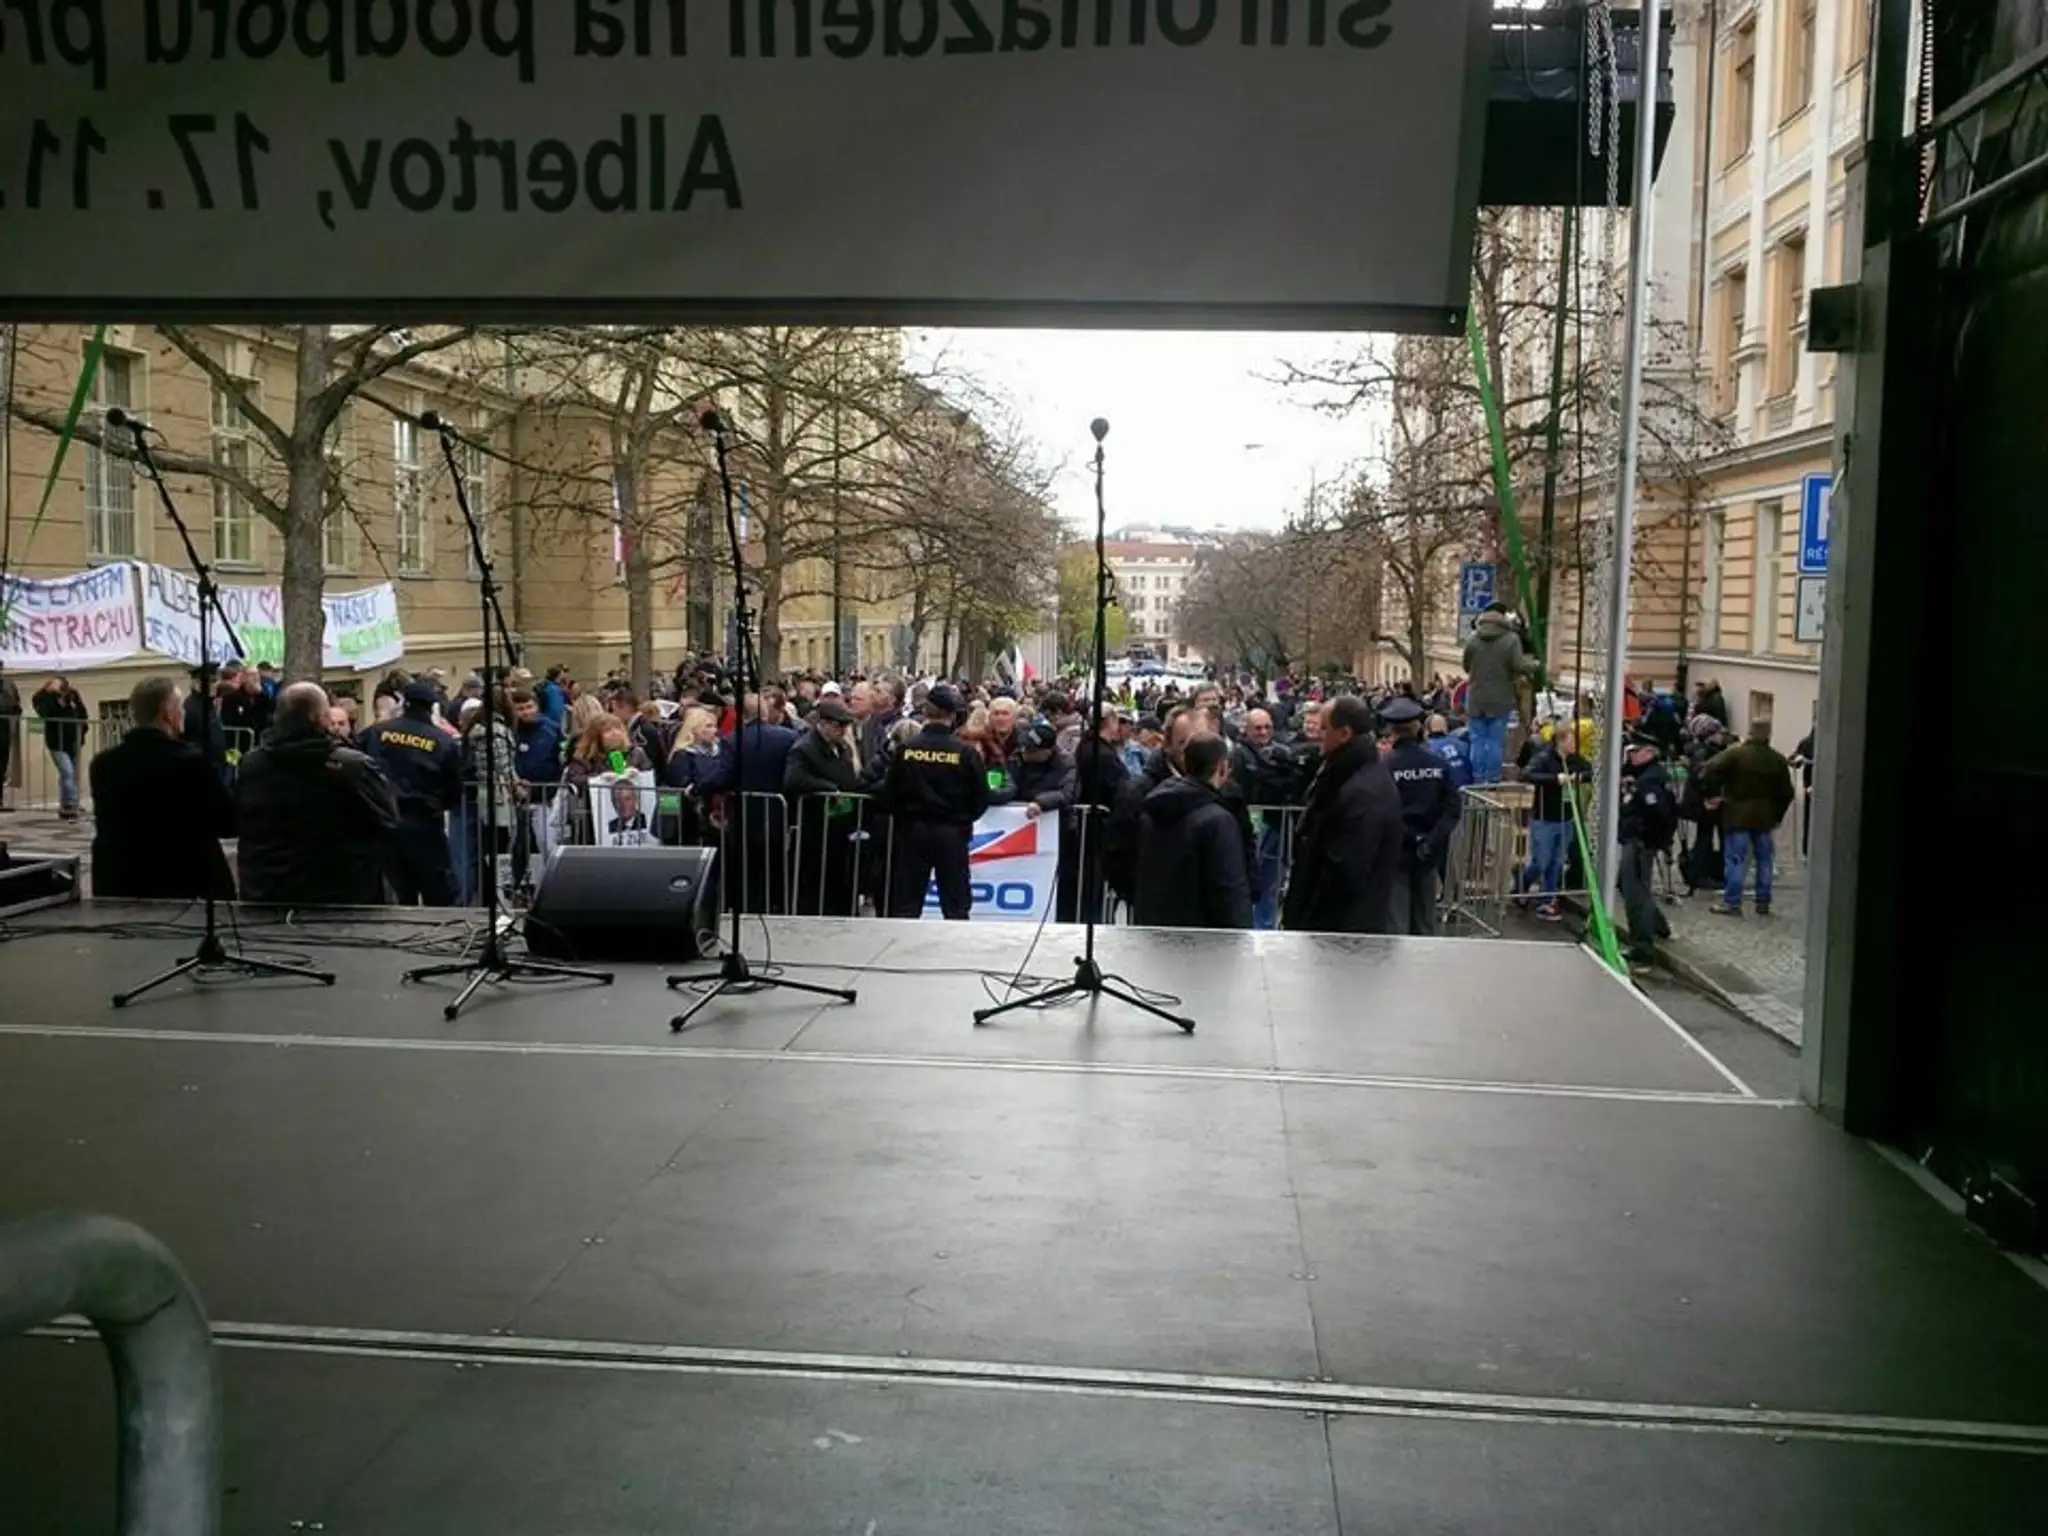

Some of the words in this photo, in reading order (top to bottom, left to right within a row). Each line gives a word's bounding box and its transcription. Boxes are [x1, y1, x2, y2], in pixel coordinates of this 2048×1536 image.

[29, 604, 134, 655] STRACHU
[381, 730, 437, 752] POLICIE
[903, 748, 961, 765] POLICIE
[1393, 767, 1444, 781] POLICE
